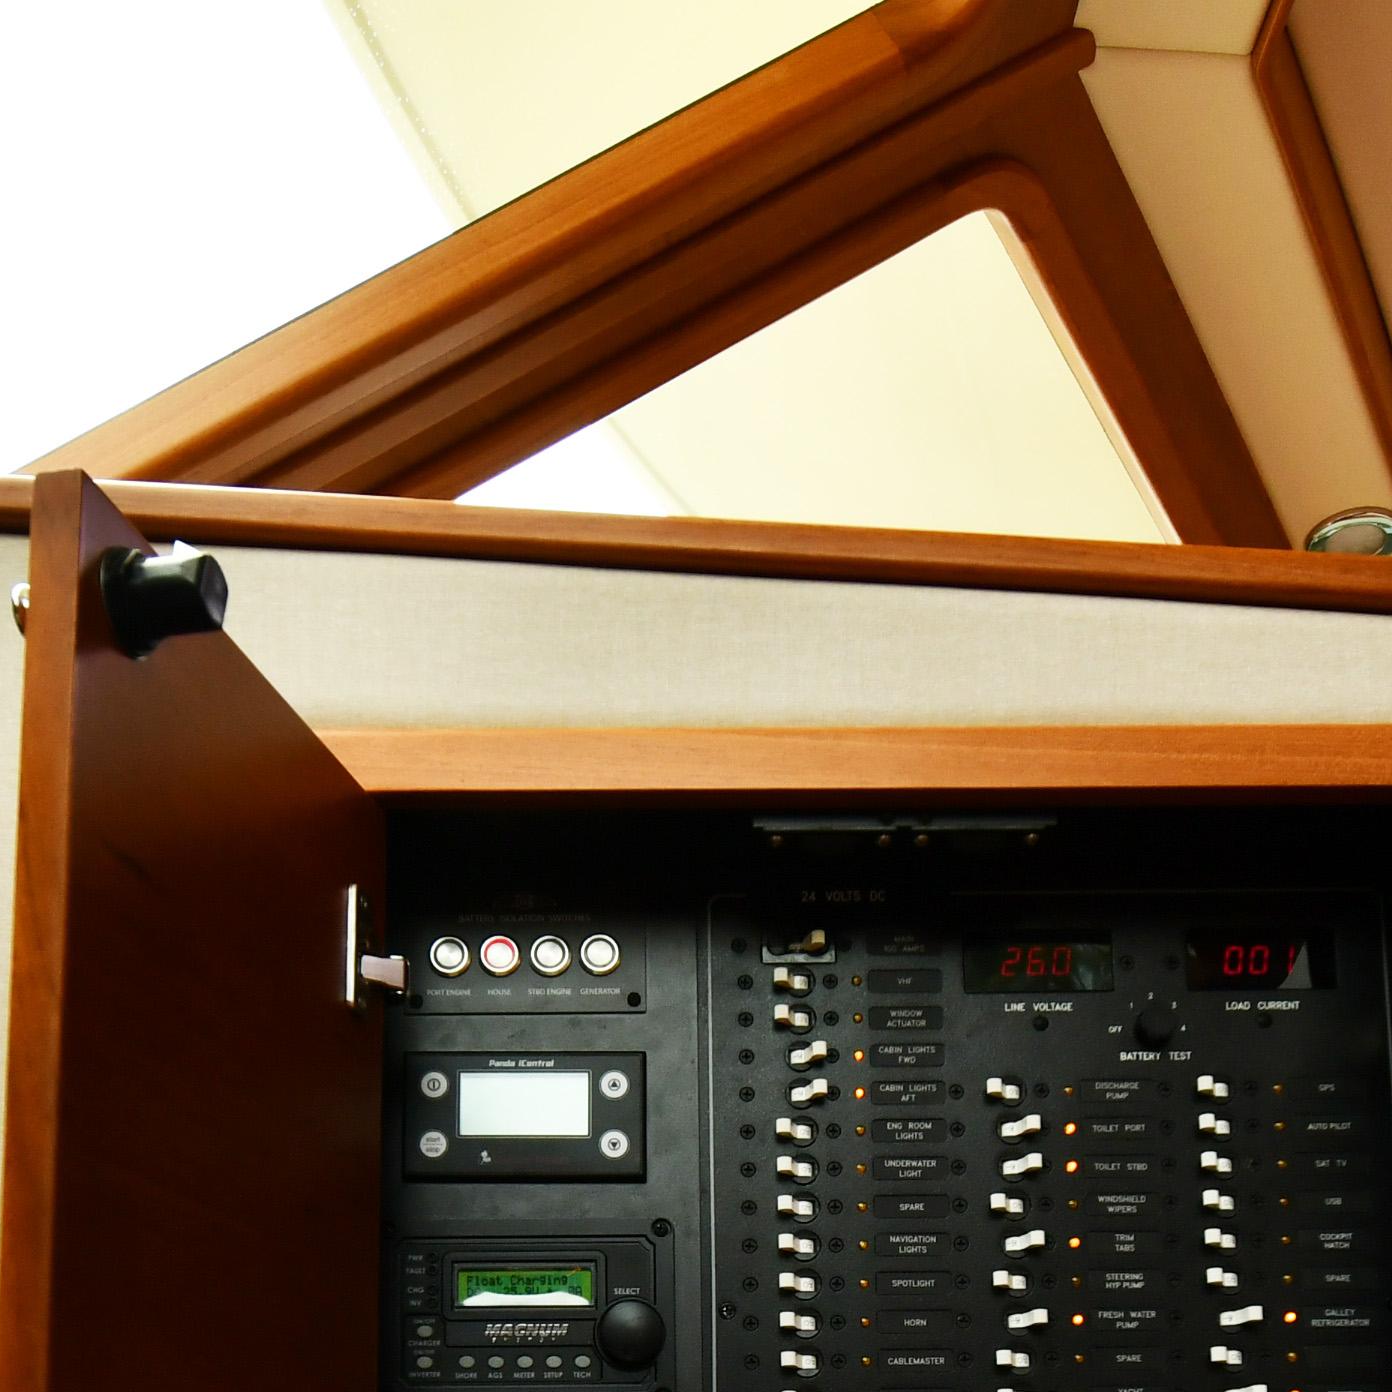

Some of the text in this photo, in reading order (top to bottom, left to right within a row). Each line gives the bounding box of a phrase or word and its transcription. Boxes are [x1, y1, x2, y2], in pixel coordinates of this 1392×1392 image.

[999, 945, 1073, 977] 260
[897, 977, 912, 985] VHF
[446, 988, 471, 997] ENGINE
[487, 988, 511, 996] HOUSE
[547, 987, 571, 996] ENGINE
[579, 987, 621, 996] GENERATOR
[1004, 1002, 1073, 1012] LINE VOLTAGE
[1225, 1001, 1301, 1011] LOAD CURRENT
[890, 1009, 923, 1017] WINDOW
[887, 1019, 927, 1028] ACTUATOR
[1108, 1025, 1123, 1034] OFF
[878, 1046, 936, 1054] CABIN LIGHTS
[898, 1056, 917, 1064] FWD
[1120, 1051, 1192, 1061] BATTERY TEST
[488, 1059, 516, 1068] Panda
[879, 1084, 937, 1092] CABIN LIGHTS
[1095, 1082, 1140, 1090] DISCHARGE
[901, 1094, 916, 1102] AFT
[1106, 1092, 1129, 1100] PUMP
[887, 1122, 932, 1130] ENG ROOM
[1092, 1124, 1146, 1132] TOILET PORT
[1307, 1122, 1351, 1130] AUTO PILOT
[896, 1132, 924, 1140] LIGHTS
[884, 1159, 936, 1167] UNDERWATER
[1094, 1162, 1121, 1171] TOILET
[1336, 1159, 1347, 1168] TV
[899, 1170, 923, 1178] LIGHT
[1098, 1195, 1147, 1203] WINDSHIELD
[899, 1203, 924, 1211] SPARE
[1107, 1205, 1137, 1213] WIPERS
[890, 1235, 936, 1243] NAVIGATION
[1319, 1232, 1352, 1241] COCKPIT
[899, 1246, 927, 1254] LIGHTS
[1106, 1273, 1144, 1281] STEERING
[466, 1275, 568, 1288] Float Charging
[891, 1279, 936, 1288] SPOTLIGHT
[614, 1287, 641, 1295] SELECT
[1098, 1310, 1157, 1319] FRESH WATER
[1324, 1308, 1356, 1317] GALLEY
[903, 1318, 927, 1327] HORN
[1116, 1321, 1140, 1329] PUMP
[484, 1323, 569, 1337] MAGNUM
[887, 1357, 945, 1365] CABLEMASTER
[1116, 1354, 1142, 1363] SPARE
[513, 1371, 535, 1379] METER
[543, 1371, 564, 1379] SETUP
